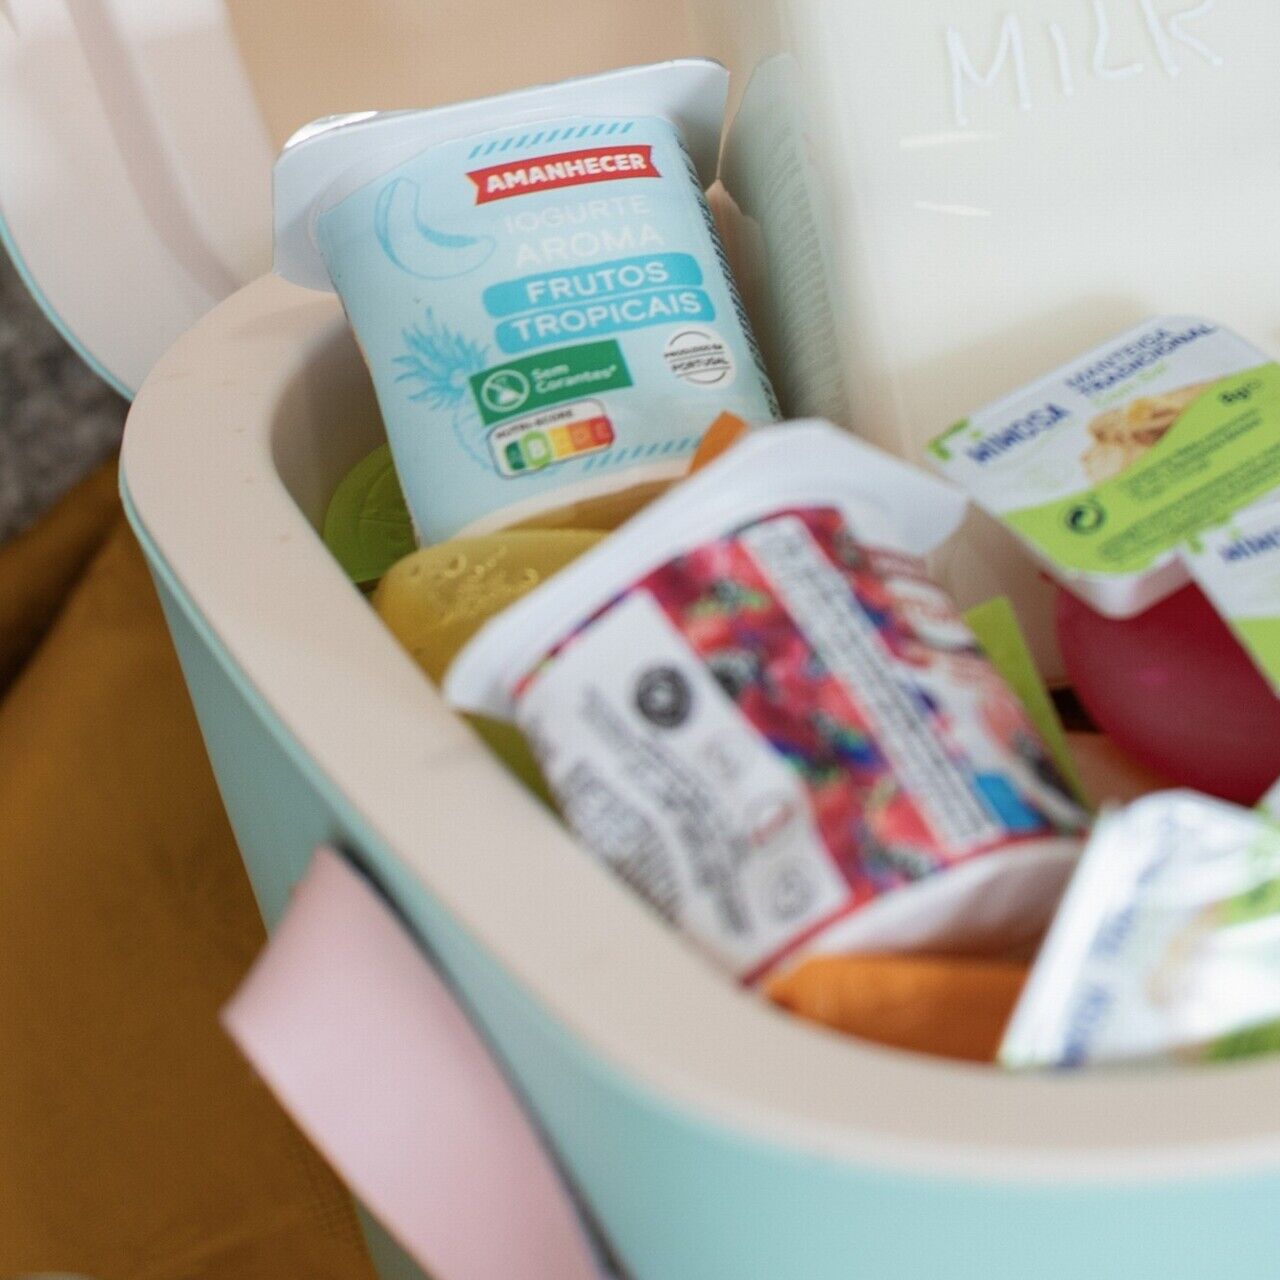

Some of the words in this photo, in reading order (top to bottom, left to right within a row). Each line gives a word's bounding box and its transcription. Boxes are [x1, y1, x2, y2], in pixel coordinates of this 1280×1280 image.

[485, 152, 648, 194] AMANHECER
[514, 225, 666, 269] AROMA
[525, 261, 669, 304] FRUTOS
[510, 293, 702, 344] TROPICAIS
